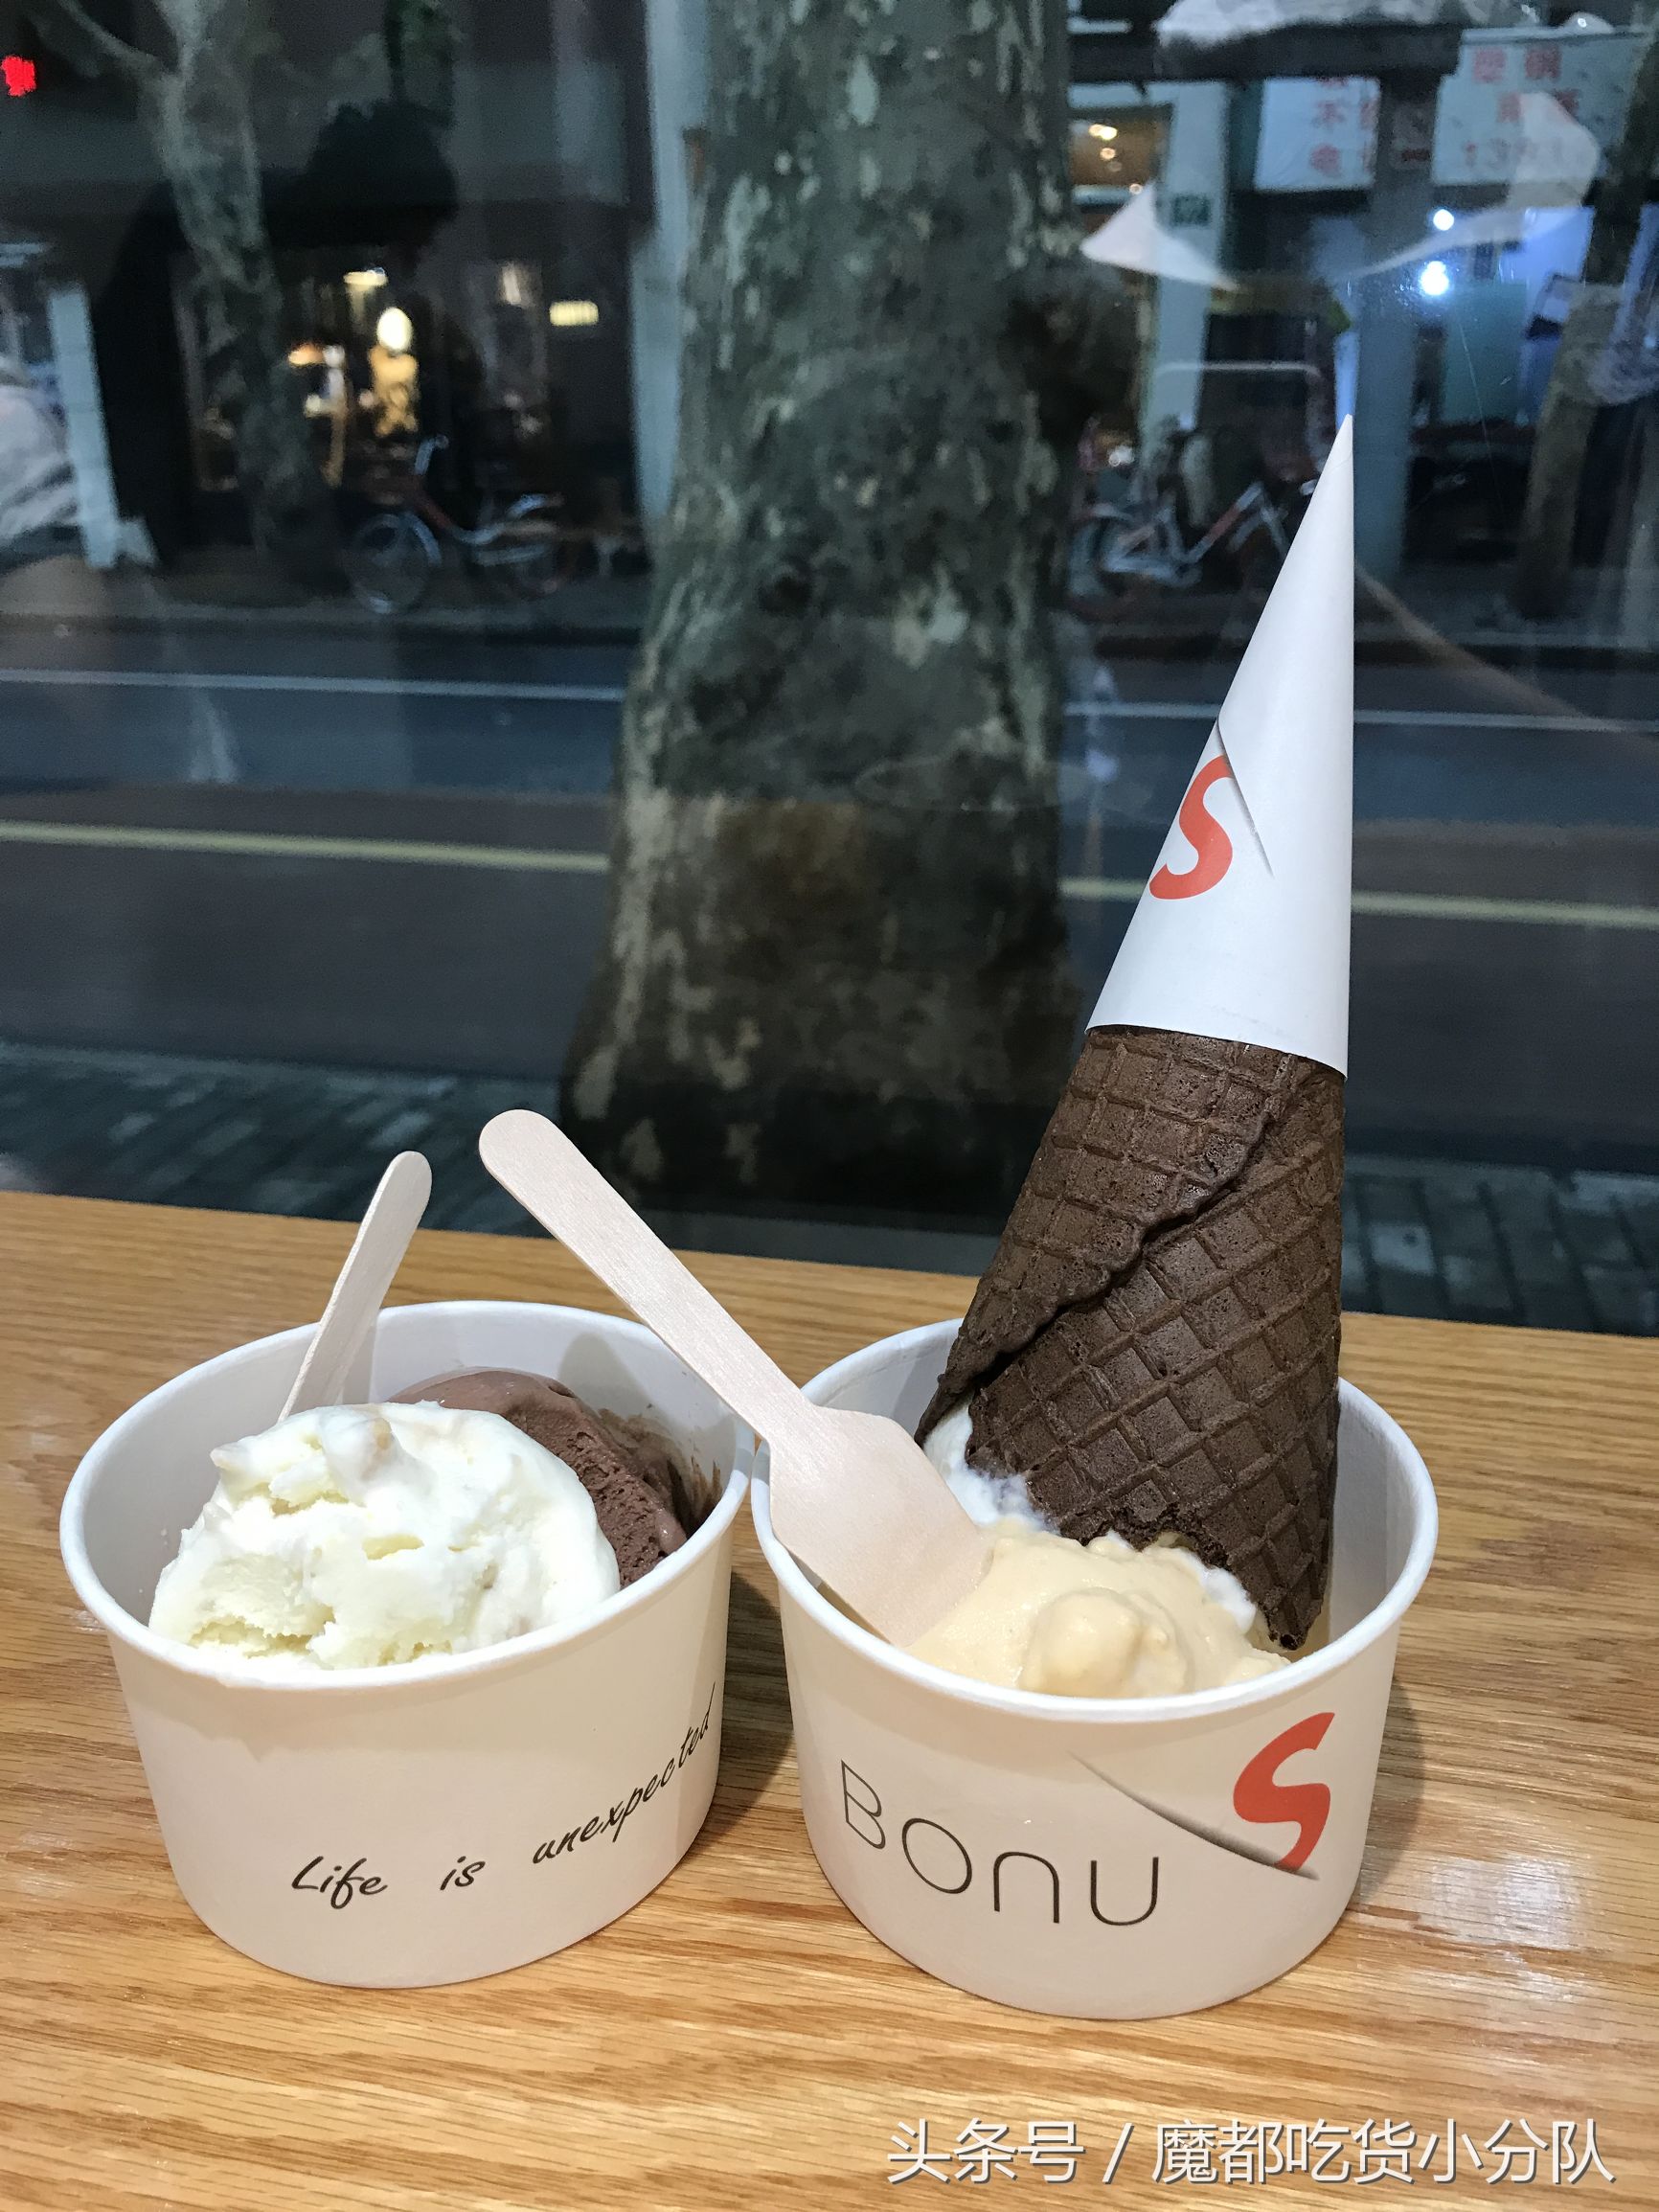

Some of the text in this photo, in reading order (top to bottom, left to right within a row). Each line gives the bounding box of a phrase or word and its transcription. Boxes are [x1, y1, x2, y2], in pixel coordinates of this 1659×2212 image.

[291, 1682, 716, 1908] Life is unexpected
